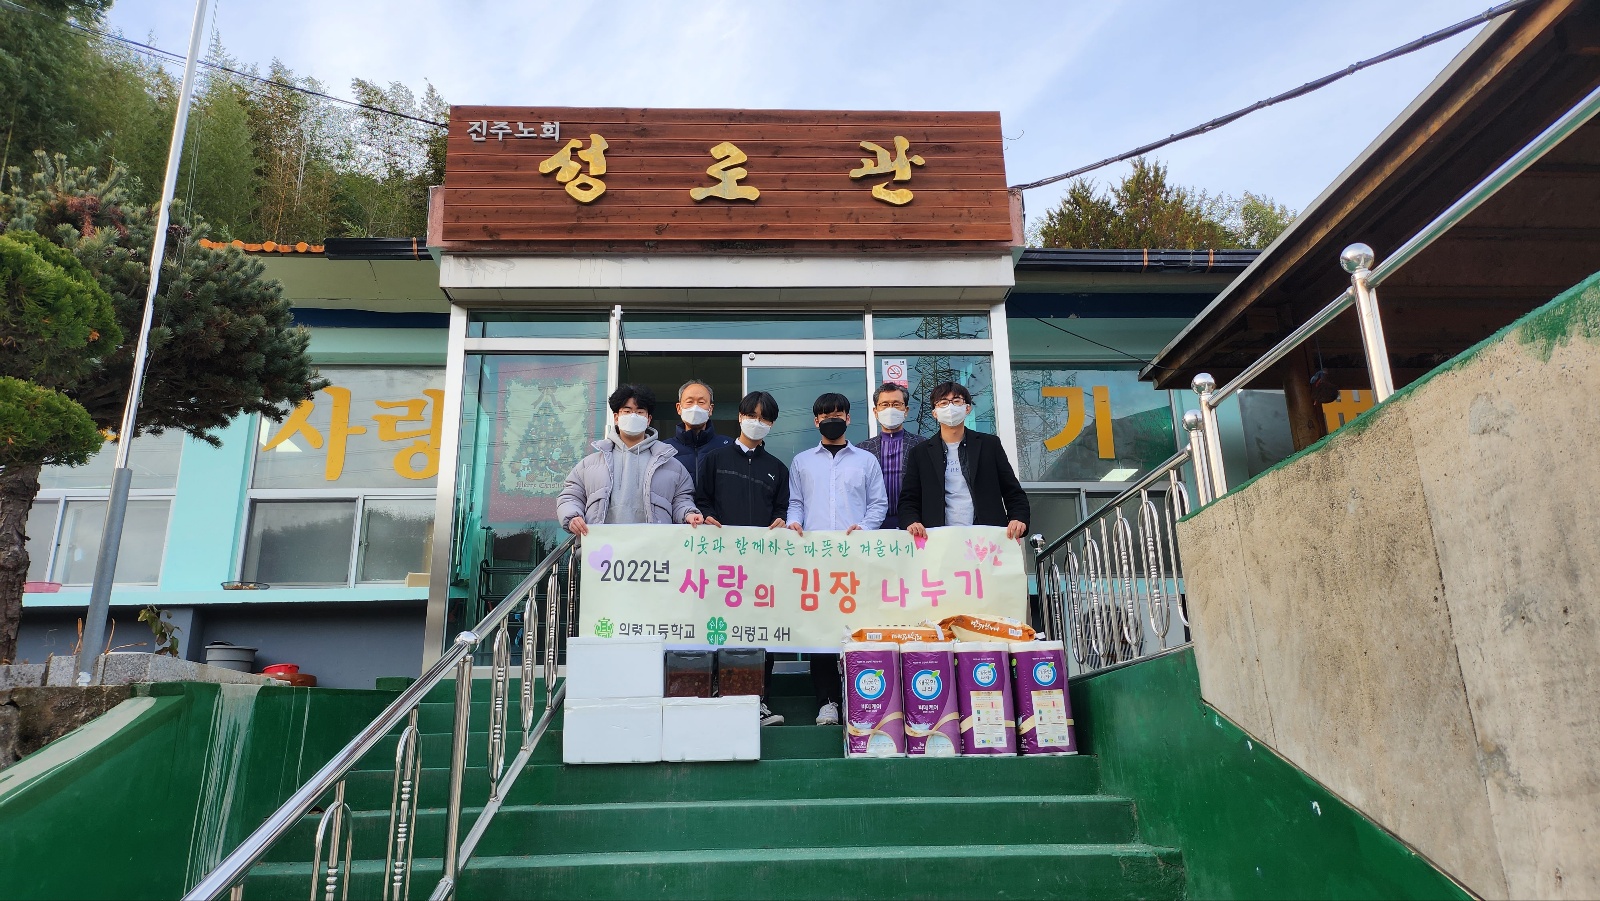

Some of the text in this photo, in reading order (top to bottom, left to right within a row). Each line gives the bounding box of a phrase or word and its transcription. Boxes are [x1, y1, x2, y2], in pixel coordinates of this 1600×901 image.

[467, 120, 560, 142] 진주노회
[683, 535, 915, 558] 이웃과 함께하는 따뜻한 겨울나기
[600, 559, 984, 614] 2022년 사랑의 김장 나누기
[731, 625, 769, 643] 의령고
[773, 626, 791, 642] 4H
